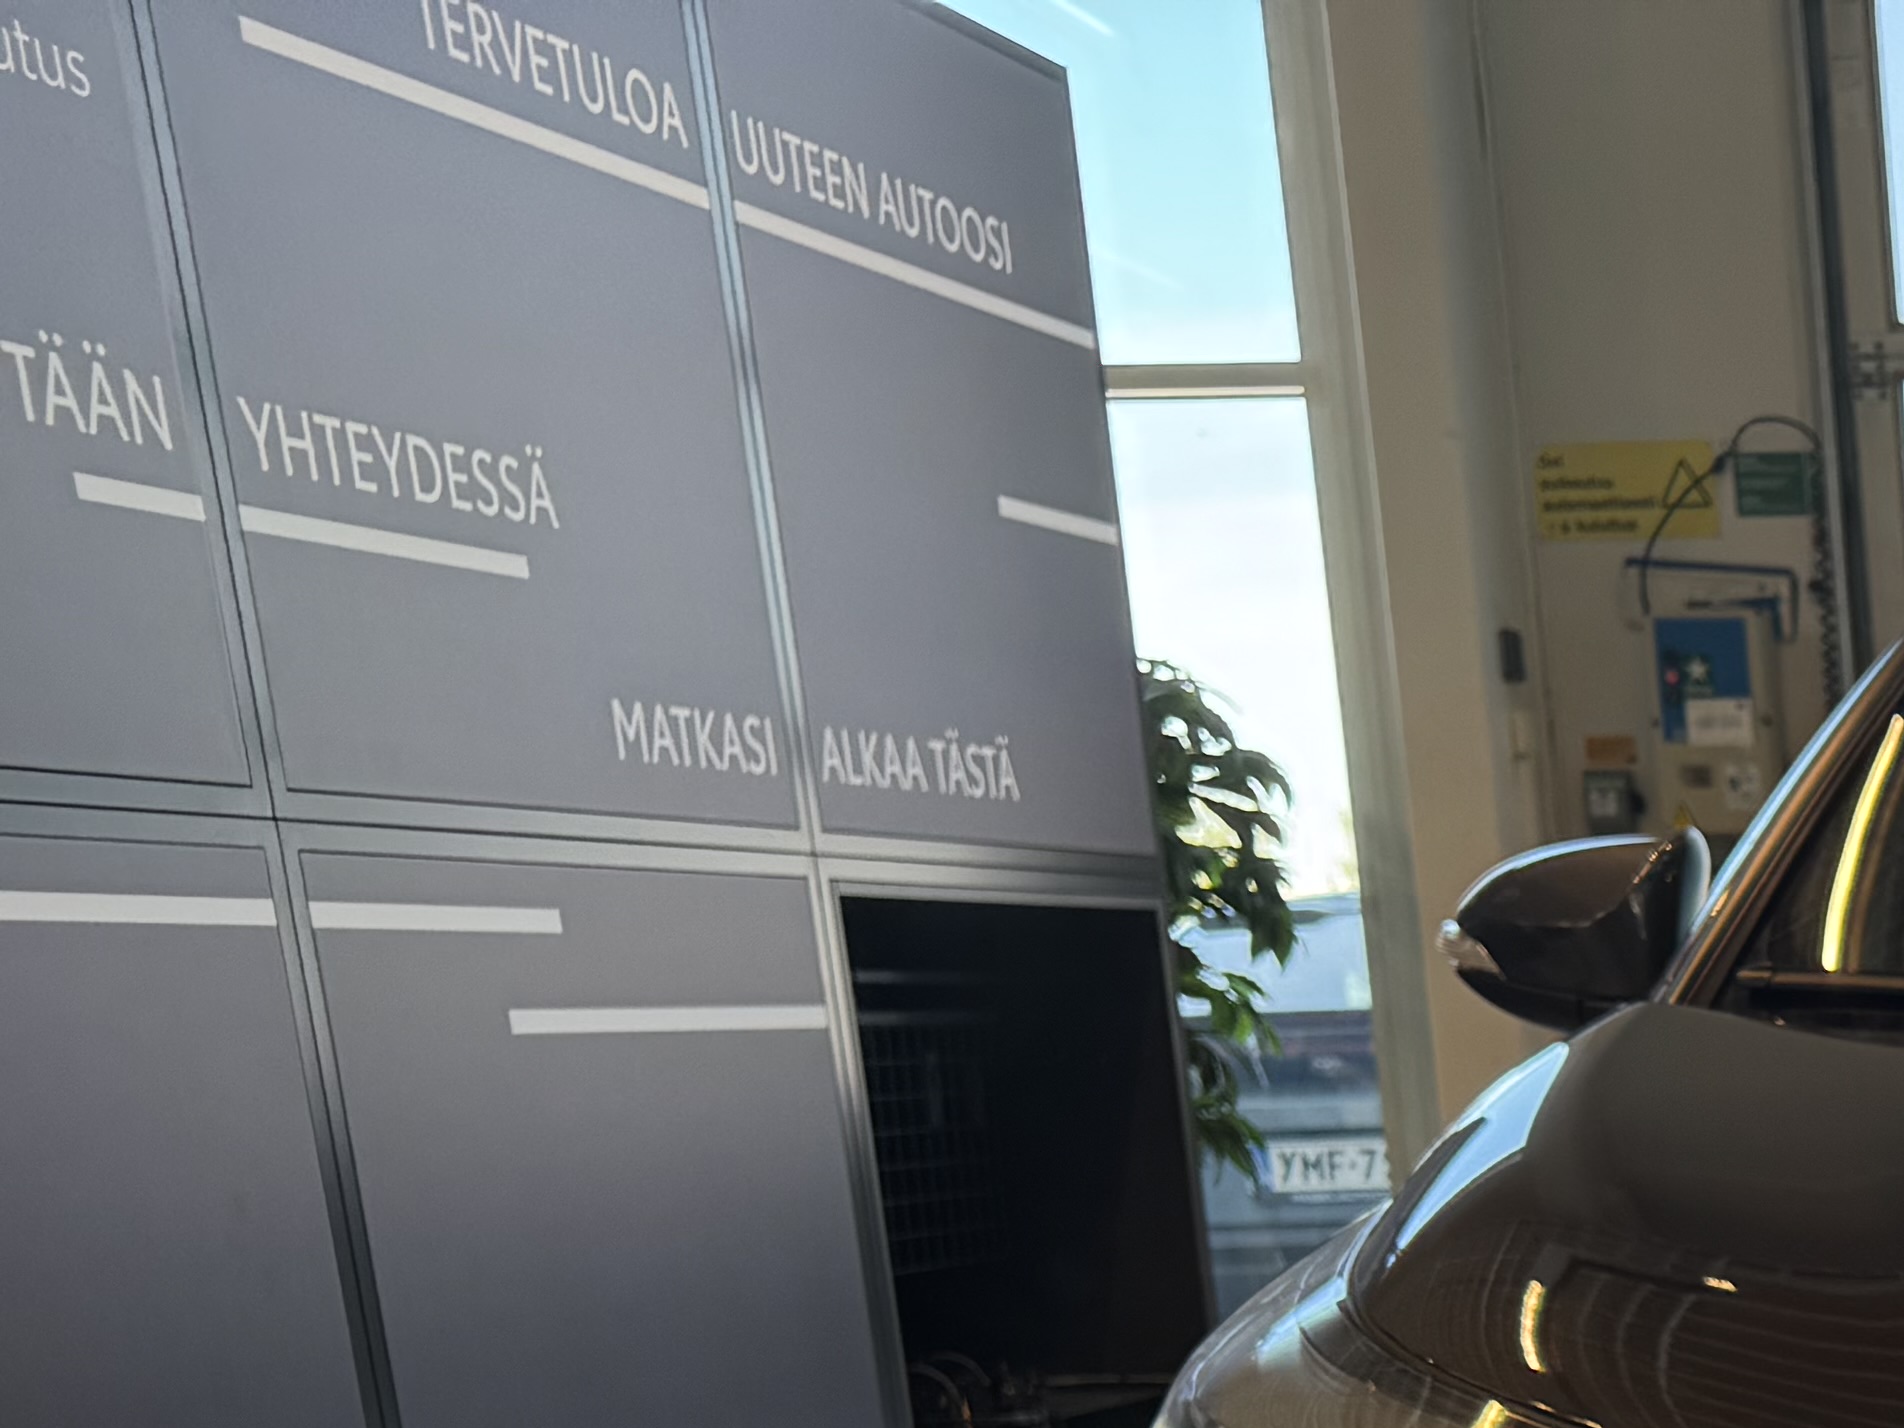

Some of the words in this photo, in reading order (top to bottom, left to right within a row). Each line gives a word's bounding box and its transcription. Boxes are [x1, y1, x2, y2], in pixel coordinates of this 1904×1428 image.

[421, 0, 689, 148] TERVETULOA
[731, 110, 869, 219] UUTEEN
[879, 172, 1012, 274] AUTOOSI
[0, 330, 173, 450] TÄÄN
[237, 396, 559, 529] YHTEYDESSÄ
[611, 698, 777, 776] MATKASI
[822, 726, 928, 793] ALKAA
[927, 728, 1020, 801] TÄSTÄ
